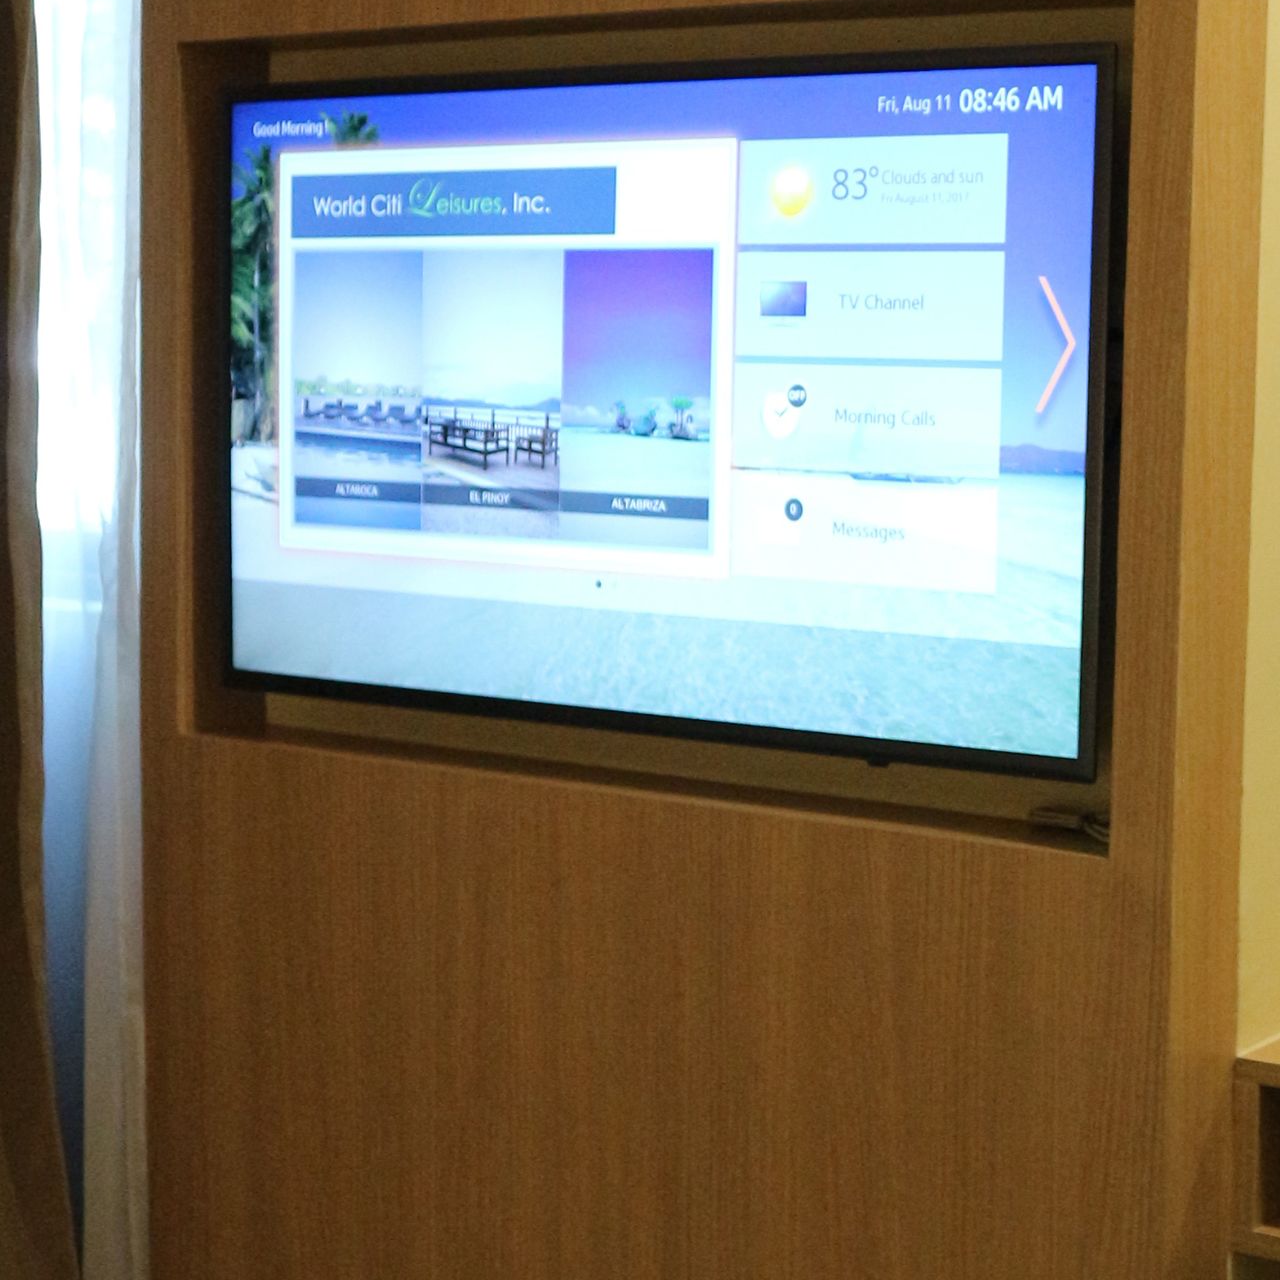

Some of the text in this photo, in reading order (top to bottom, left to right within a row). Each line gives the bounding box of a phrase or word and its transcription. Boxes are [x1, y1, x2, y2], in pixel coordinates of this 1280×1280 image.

[877, 85, 1063, 114] Fri, Aug 11 08:46 AM
[253, 121, 280, 137] Good
[281, 120, 322, 138] Morning
[832, 165, 879, 201] 83°
[881, 168, 983, 185] Clouds and sun
[313, 195, 366, 217] World
[370, 193, 402, 217] Citi
[513, 192, 551, 214] Inc.
[839, 293, 925, 310] TV Channel
[834, 408, 936, 430] Morning Calls
[469, 491, 481, 504] EL
[611, 497, 667, 512] ALTABRIZA
[832, 521, 905, 543] Messages
